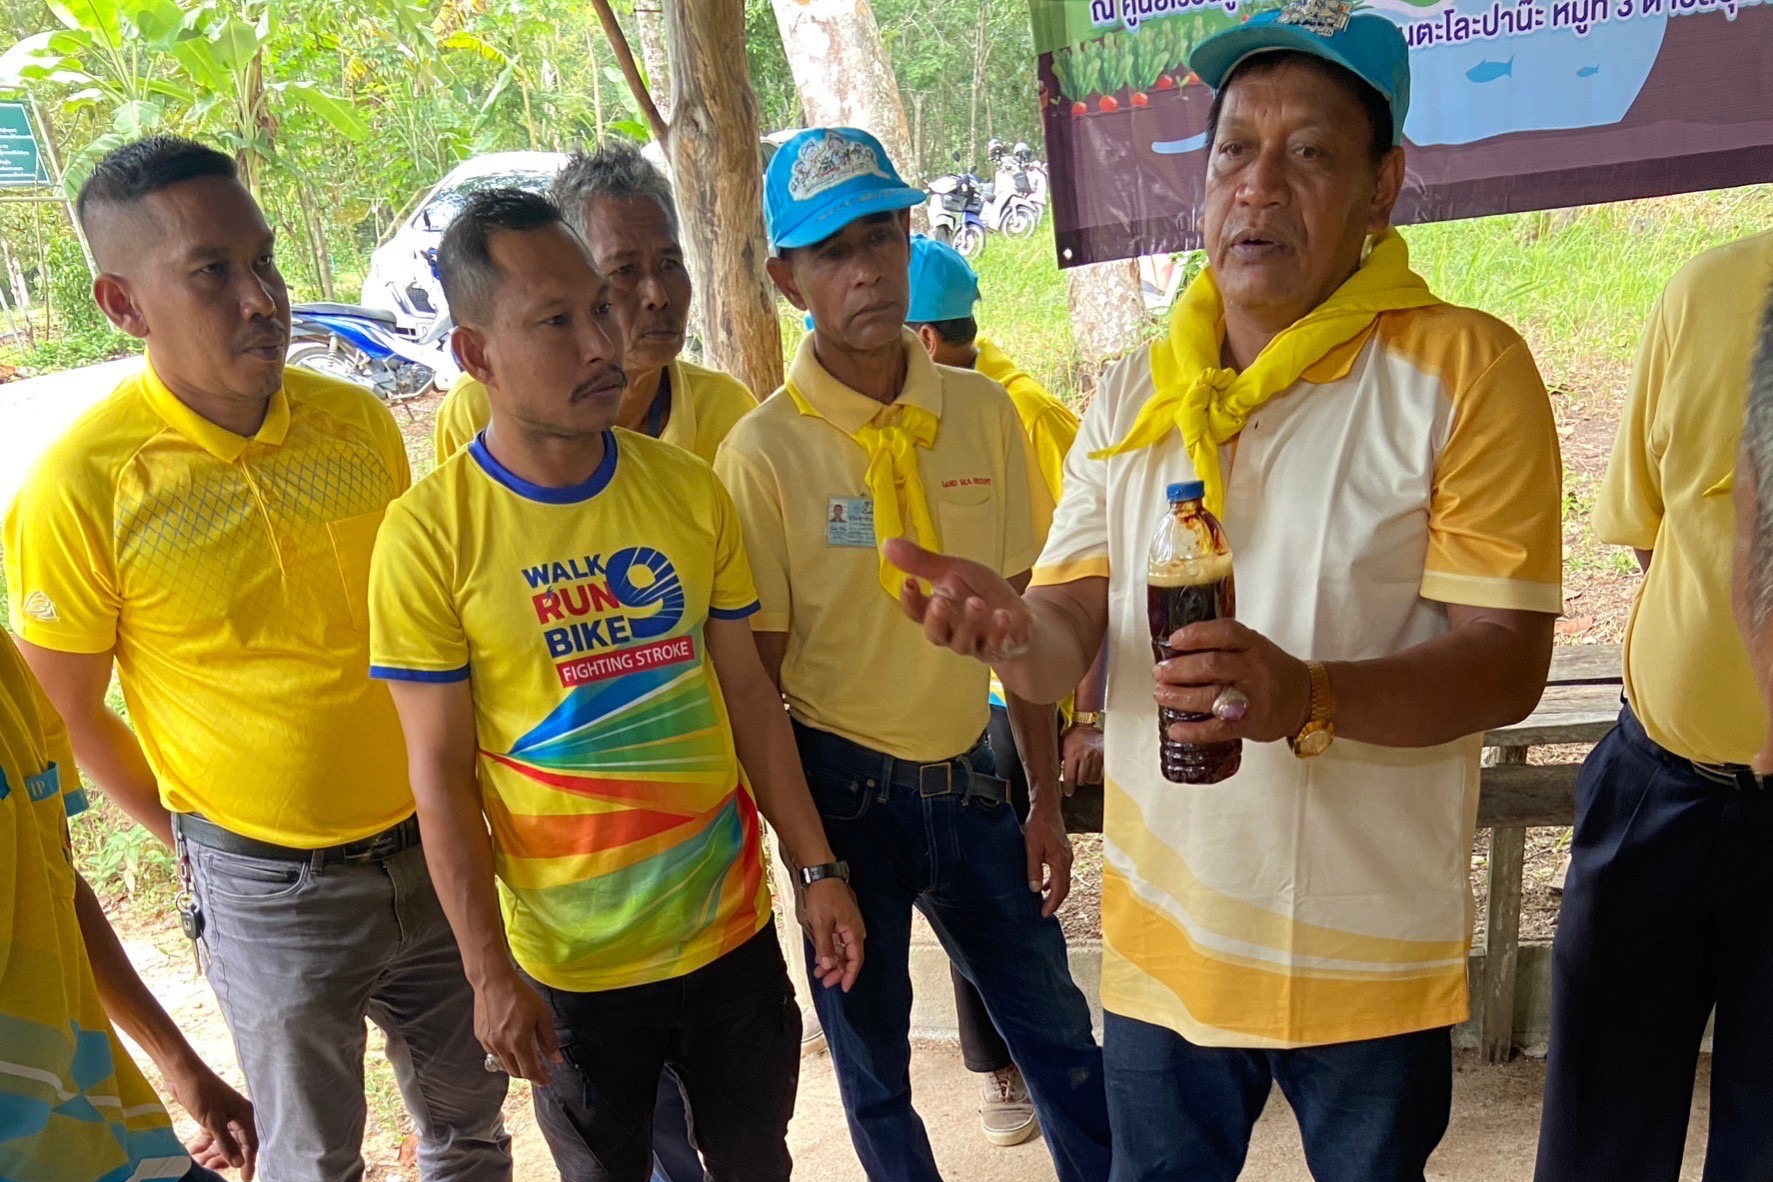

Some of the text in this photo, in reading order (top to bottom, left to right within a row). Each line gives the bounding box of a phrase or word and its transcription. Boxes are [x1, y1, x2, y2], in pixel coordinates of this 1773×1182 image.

[522, 554, 606, 589] WALK
[532, 581, 620, 625] RUN
[544, 615, 630, 658] BIKE
[562, 641, 689, 682] FIGHTING STROKE
